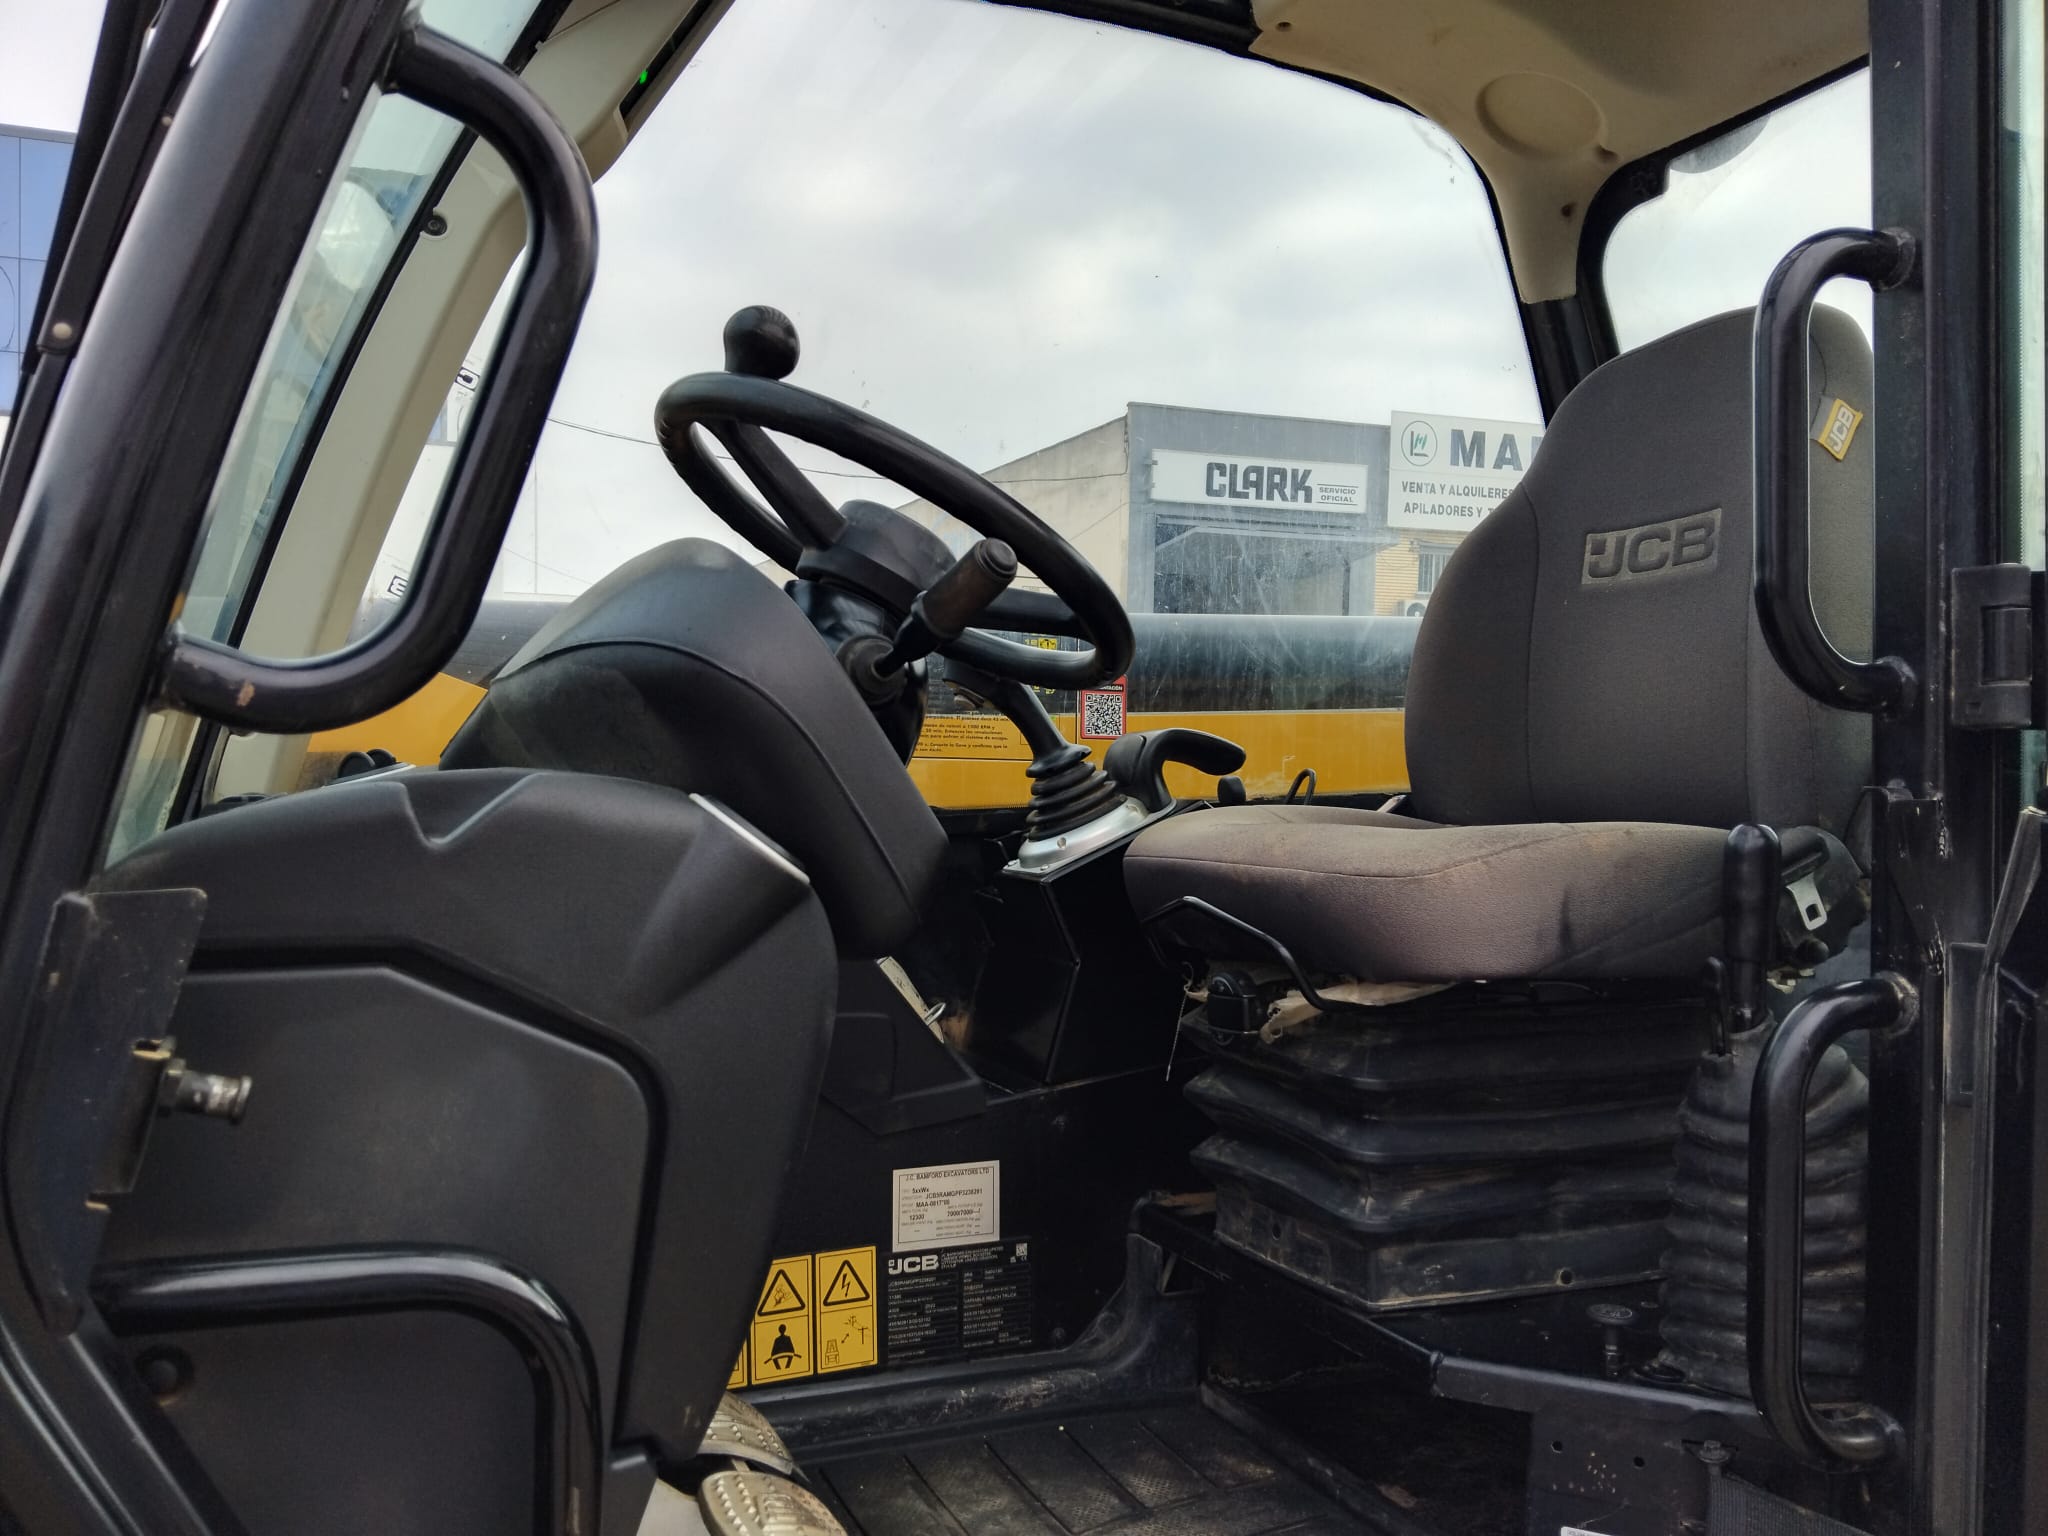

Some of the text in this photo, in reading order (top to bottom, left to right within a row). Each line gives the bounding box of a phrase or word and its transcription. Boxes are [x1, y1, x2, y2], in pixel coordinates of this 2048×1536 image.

[1827, 405, 1855, 452] JCB
[1450, 428, 1545, 471] MA
[1205, 462, 1313, 504] CLARK
[1319, 486, 1357, 495] SERVICIO
[1401, 481, 1436, 495] VENTA
[1439, 484, 1446, 495] Y
[1320, 494, 1354, 503] OFICIAL
[1403, 501, 1474, 518] APILADORES
[1476, 507, 1483, 518] Y
[1587, 516, 1716, 580] JCB
[916, 1170, 942, 1180] BAMFORD
[943, 1168, 978, 1178] EXCAVATORS
[888, 1254, 939, 1275] JCB
